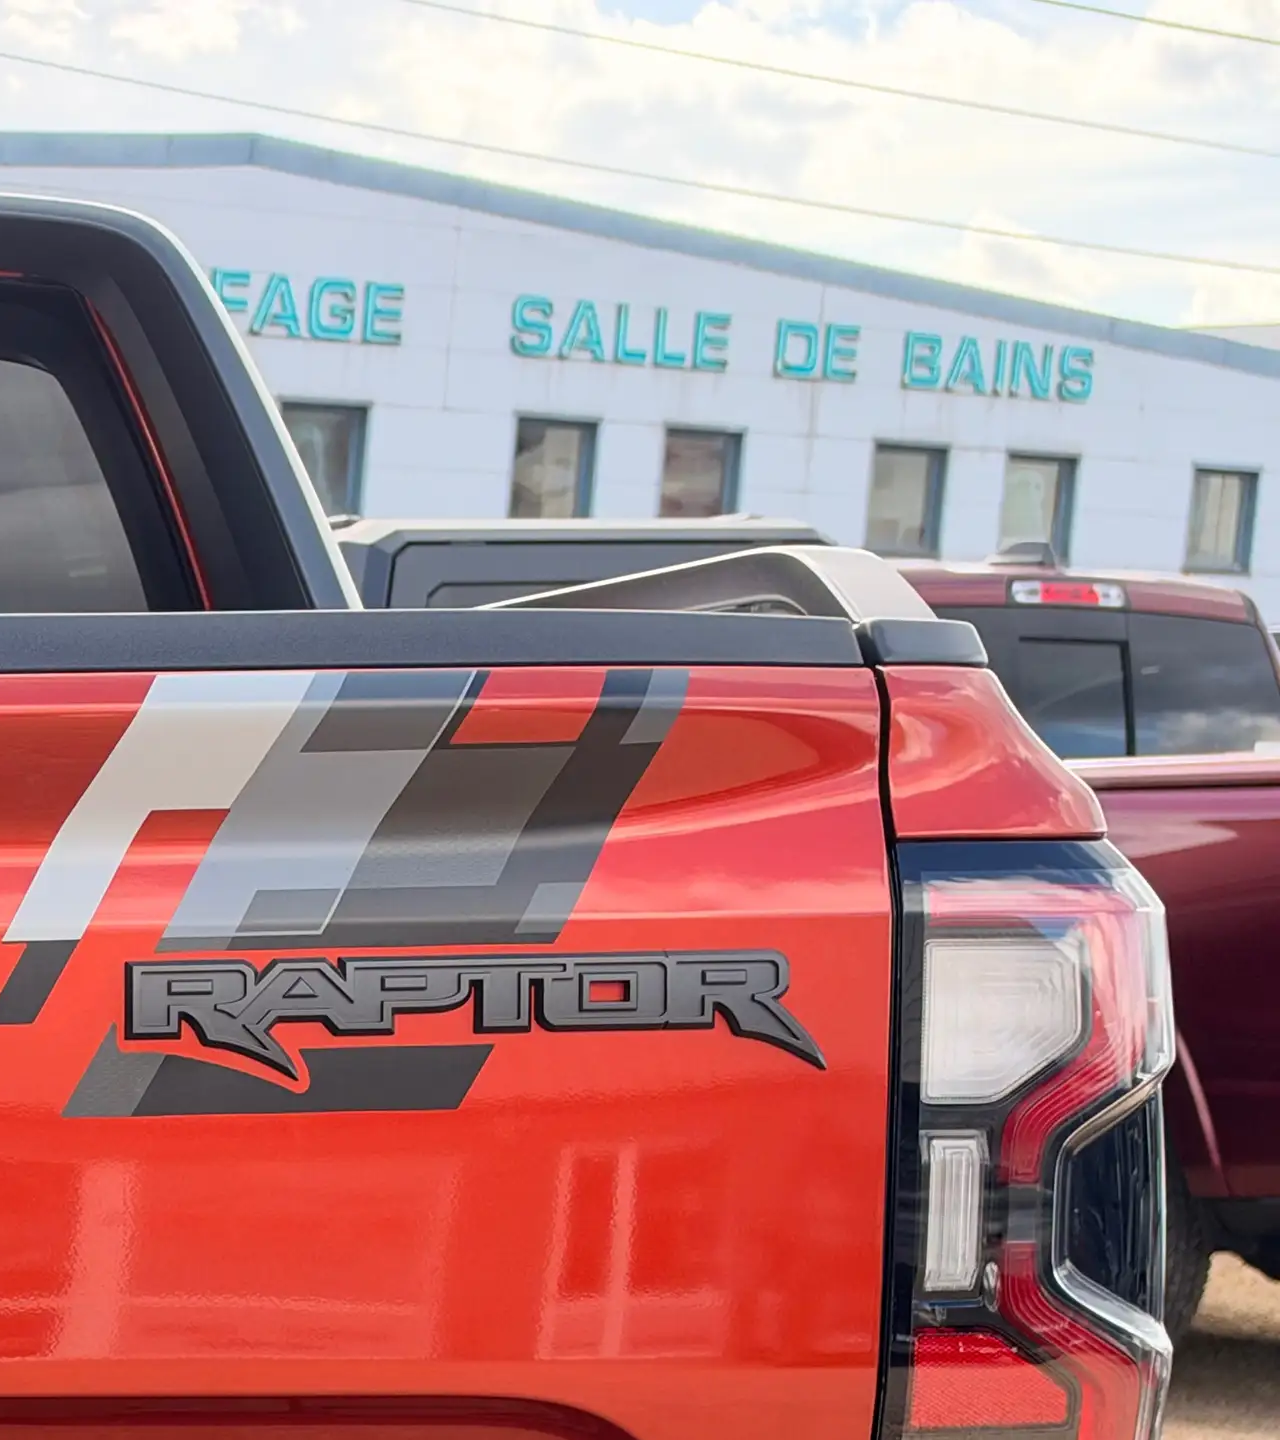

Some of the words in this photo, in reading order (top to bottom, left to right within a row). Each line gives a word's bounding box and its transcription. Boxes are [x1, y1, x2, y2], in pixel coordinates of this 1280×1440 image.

[510, 293, 733, 371] SALLE
[774, 317, 861, 383] DE
[901, 329, 1096, 404] BAINS
[124, 948, 828, 1081] RAPTOR
